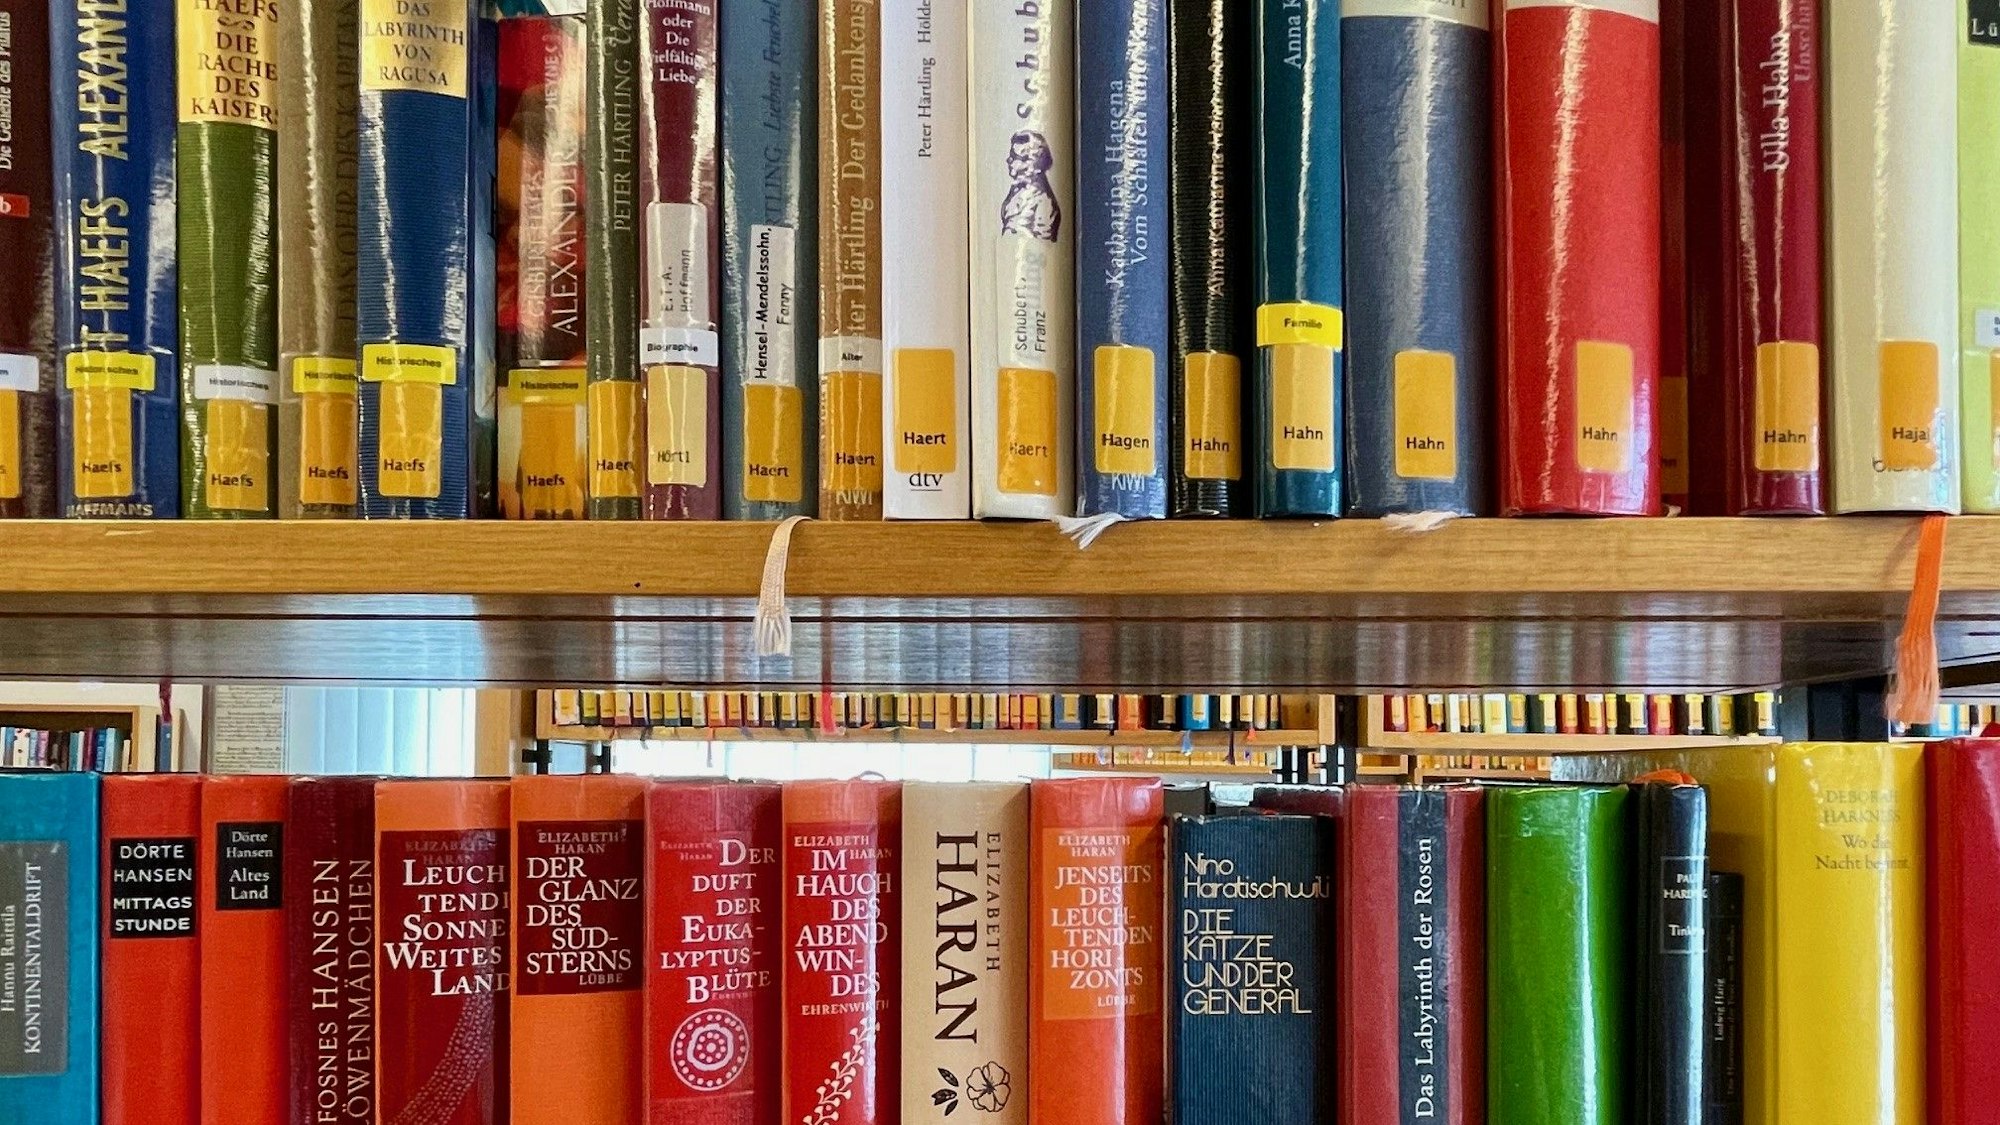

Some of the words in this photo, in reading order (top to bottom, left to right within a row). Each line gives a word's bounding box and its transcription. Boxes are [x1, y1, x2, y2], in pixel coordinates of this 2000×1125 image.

[396, 0, 430, 17] DAS
[662, 13, 694, 28] oder
[216, 31, 259, 55] DIE
[364, 20, 465, 46] LABYRINTH
[666, 31, 690, 46] Die
[1284, 15, 1301, 70] Anna
[393, 44, 433, 60] VON
[198, 53, 278, 81] RACHE
[379, 66, 448, 86] RAGUSA
[660, 68, 698, 84] Liebe
[1759, 31, 1790, 109] Hahn
[216, 76, 260, 99] DES
[917, 57, 936, 118] Härtling
[612, 58, 632, 163] HÄRTLING
[762, 71, 783, 131] Liebste
[1104, 79, 1128, 163] Hagena
[918, 123, 933, 158] Peter
[1760, 118, 1790, 173] Ulla
[842, 139, 866, 181] Der
[613, 171, 631, 232] PETER
[551, 149, 578, 337] ALEXANDER
[1104, 174, 1126, 288] Katharina
[1130, 214, 1148, 265] Vom
[79, 196, 129, 309] HAEFS
[841, 195, 874, 292] Härtling
[524, 238, 546, 317] GISBERT
[1207, 247, 1225, 297] Anna
[755, 227, 772, 380] Hensel-Mendelssohn,
[776, 283, 795, 326] Fanny
[1015, 277, 1028, 351] Schubert,
[1035, 311, 1047, 353] Franz
[1284, 317, 1323, 329] Familie
[376, 355, 442, 369] Historisches
[842, 353, 864, 362] Alter
[904, 432, 947, 445] Haert
[1102, 433, 1150, 449] Hagen
[1191, 438, 1230, 452] Hahn
[1284, 426, 1323, 440] Hahn
[1406, 437, 1445, 450] Hahn
[1582, 427, 1617, 441] Hahn
[1764, 430, 1807, 444] Hahn
[835, 452, 876, 466] Haert
[1010, 442, 1049, 458] Haert
[82, 462, 122, 474] Haefs
[308, 466, 349, 480] Haefs
[384, 459, 426, 472] Haefs
[749, 463, 790, 477] Haert
[211, 475, 254, 487] Haefs
[527, 475, 566, 487] Haefs
[909, 472, 943, 487] dtv
[1112, 472, 1145, 491] KIWI
[231, 830, 269, 844] Dörte
[538, 829, 622, 844] ELIZABETH
[794, 834, 870, 848] ELIZABETH
[1058, 834, 1131, 847] ELIZABETH
[1842, 834, 1868, 849] Wo
[119, 843, 185, 859] DÖRTE
[226, 846, 274, 859] Hansen
[555, 843, 606, 855] HARAN
[719, 838, 776, 867] DER
[811, 849, 848, 872] IM
[850, 848, 893, 861] HARAN
[1071, 846, 1116, 858] HARAN
[403, 859, 505, 886] LEUCH
[527, 856, 587, 880] DER
[1184, 853, 1234, 876] Nino
[1414, 837, 1433, 905] Rosen
[1815, 854, 1861, 870] Nacht
[113, 868, 192, 883] HANSEN
[229, 869, 271, 884] Altes
[692, 873, 757, 893] DUFT
[796, 871, 892, 897] HAUCH
[1055, 865, 1152, 889] JENSEITS
[1184, 876, 1331, 899] Haratischwili
[230, 886, 269, 901] Land
[538, 878, 639, 903] GLANZ
[985, 832, 1001, 971] ELIZABETH
[1079, 887, 1123, 907] DES
[113, 896, 193, 910] MITTAGS
[716, 898, 762, 917] DER
[831, 898, 881, 922] DES
[115, 917, 191, 932] STUNDE
[526, 904, 582, 927] DES
[1051, 906, 1136, 928] LEUCH-
[1183, 909, 1235, 935] DIE
[1, 904, 16, 957] Raittila
[312, 859, 340, 1011] HANSEN
[403, 914, 507, 942] SONNE
[552, 924, 619, 951] SÜD-
[681, 915, 766, 944] EUKA-
[795, 922, 889, 948] ABEND
[934, 830, 979, 1045] HARAN
[1063, 925, 1153, 948] TENDEN
[1413, 914, 1434, 951] der
[24, 862, 42, 1055] KONTINENTALDRIFT
[384, 941, 502, 970] WEITES
[660, 947, 762, 970] LYPTUS-
[1183, 935, 1274, 961] KATZE
[527, 949, 632, 975] STERNS
[795, 950, 864, 973] WIN-
[1, 962, 16, 1012] Hannu
[431, 968, 511, 996] LAND
[579, 973, 624, 986] LÜBBE
[686, 967, 772, 1004] BLÜTE
[830, 972, 881, 998] DES
[1069, 967, 1144, 990] ZONTS
[1183, 962, 1242, 988] UND
[1244, 962, 1294, 988] DER
[1184, 988, 1312, 1015] GENERAL
[1714, 977, 1727, 1005] Harig
[1413, 956, 1438, 1066] Labyrinth
[1714, 1006, 1727, 1042] Ludwig
[317, 1021, 339, 1123] FOSNES
[1414, 1069, 1434, 1118] Das
